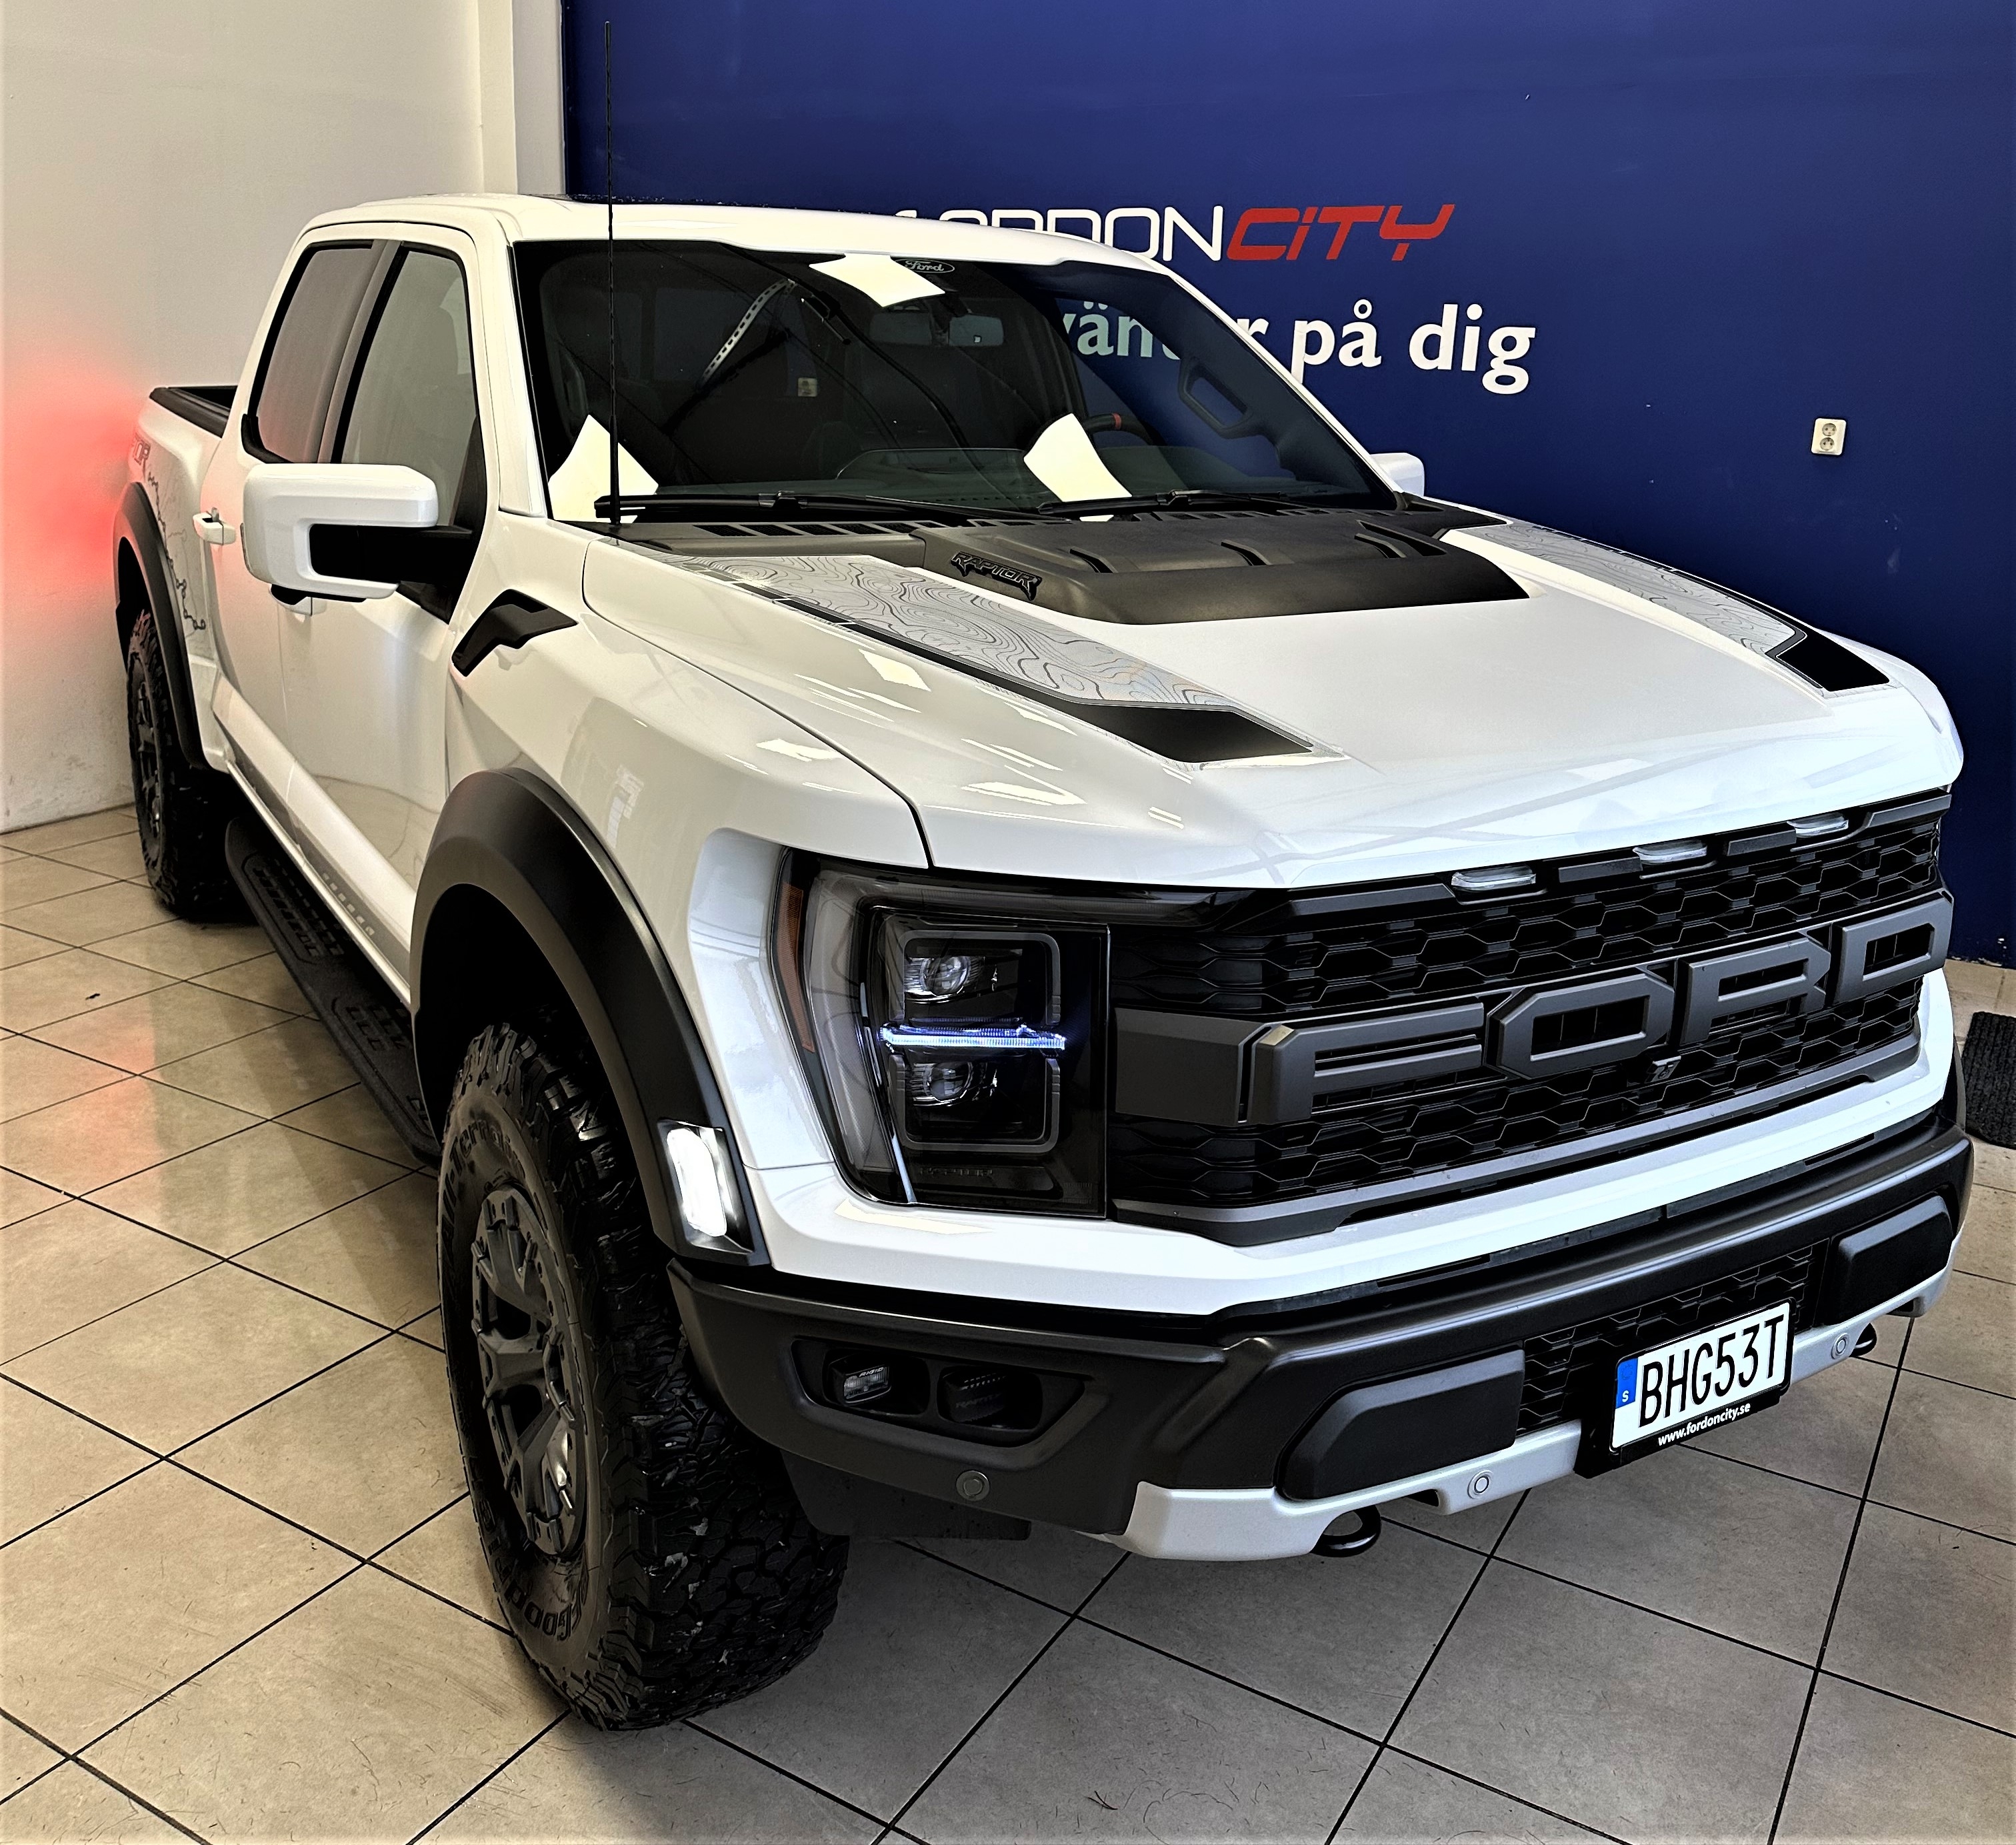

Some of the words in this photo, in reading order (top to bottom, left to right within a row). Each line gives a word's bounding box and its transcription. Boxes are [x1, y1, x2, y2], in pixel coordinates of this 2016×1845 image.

[904, 259, 945, 273] Ford
[1291, 299, 1381, 384] på
[1409, 303, 1536, 395] dig
[950, 551, 1043, 601] RAPTOR
[1249, 891, 1955, 1128] FORD
[1638, 1314, 1785, 1428] BHG53T
[1621, 1390, 1629, 1403] S
[1657, 1402, 1751, 1446] www.fordoncity.se
